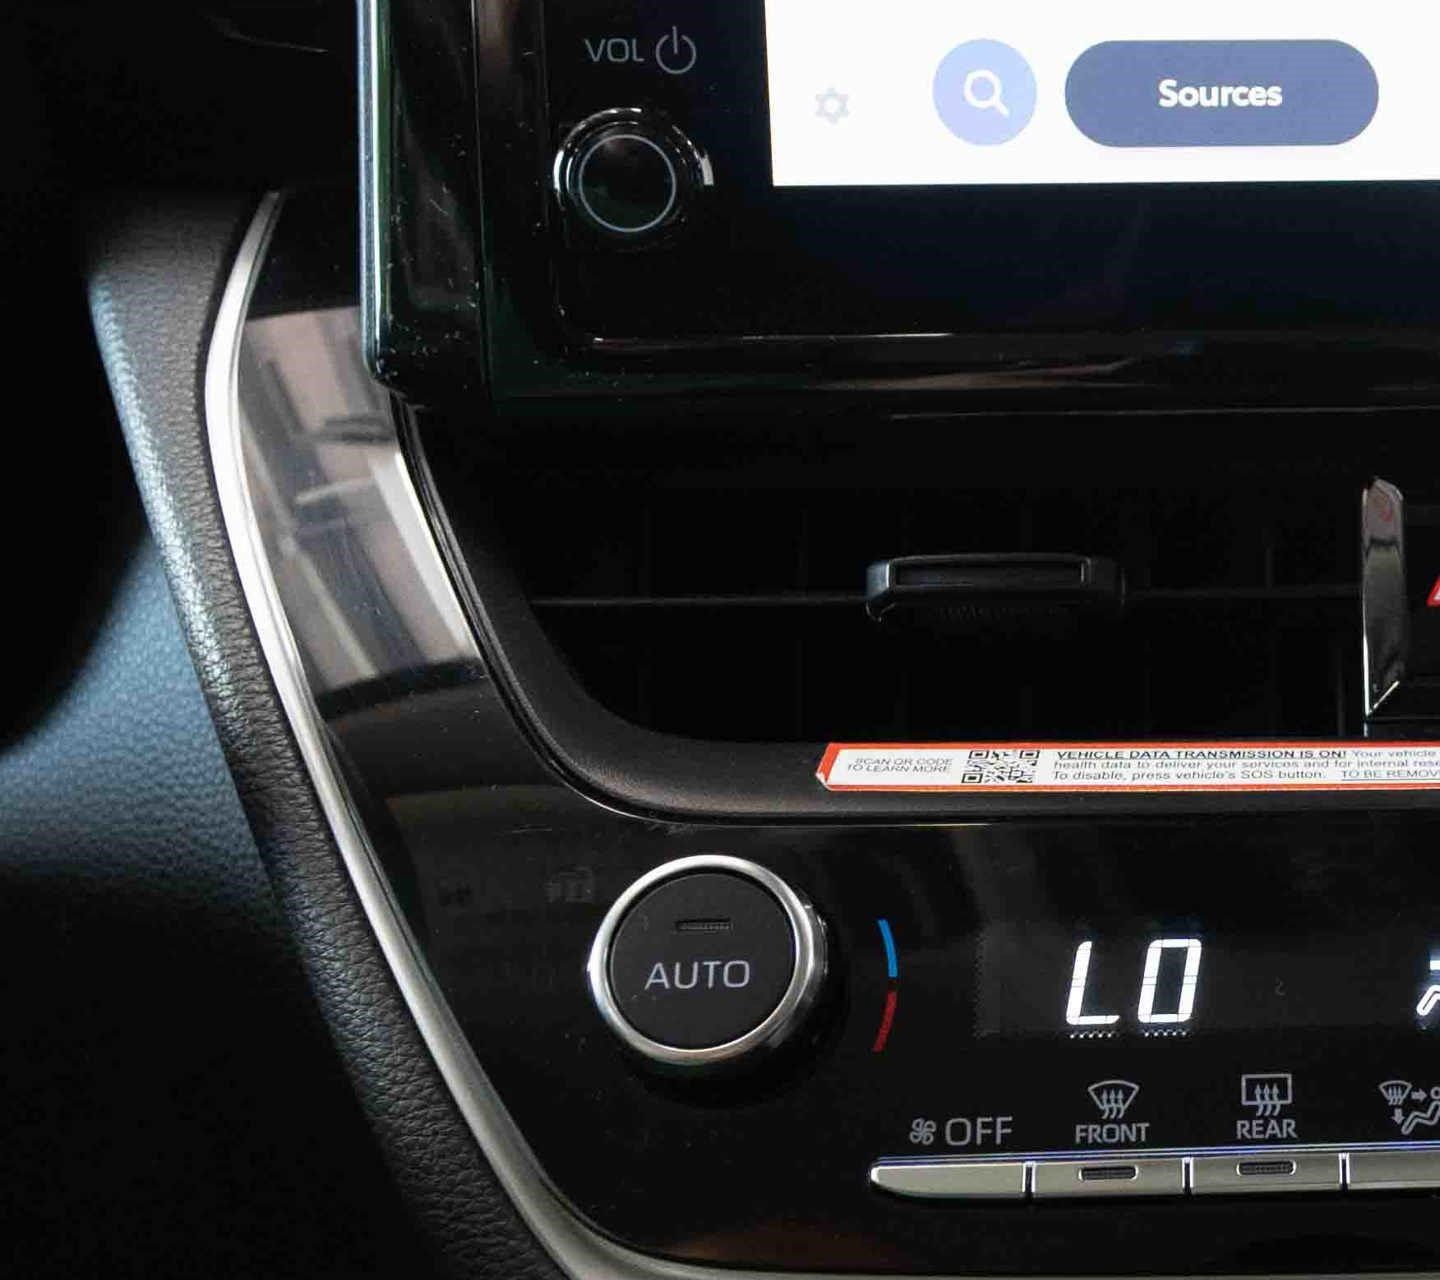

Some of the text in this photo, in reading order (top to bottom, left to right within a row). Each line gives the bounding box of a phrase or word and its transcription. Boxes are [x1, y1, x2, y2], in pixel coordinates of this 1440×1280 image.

[584, 37, 645, 62] VOL
[1158, 78, 1283, 108] Sources
[1054, 760, 1097, 769] health
[1101, 760, 1131, 769] data
[1155, 759, 1202, 769] deliver
[1207, 760, 1236, 771] your
[1241, 759, 1299, 769] services
[1304, 758, 1329, 768] and
[1357, 758, 1409, 768] internal
[1056, 750, 1124, 760] VEHICLE
[1128, 750, 1170, 760] DATA
[1175, 750, 1295, 760] TRANSMISSION
[1299, 750, 1314, 759] IS
[1353, 749, 1383, 758] Your
[1388, 749, 1436, 758] vehicle
[1053, 771, 1068, 781] To
[1131, 772, 1170, 782] press
[1240, 769, 1273, 780] SOS
[643, 959, 751, 991] AUTO
[1065, 938, 1203, 1026] LO
[944, 1116, 1014, 1147] OFF
[1073, 1121, 1151, 1145] FRONT
[1235, 1119, 1298, 1140] REAR
